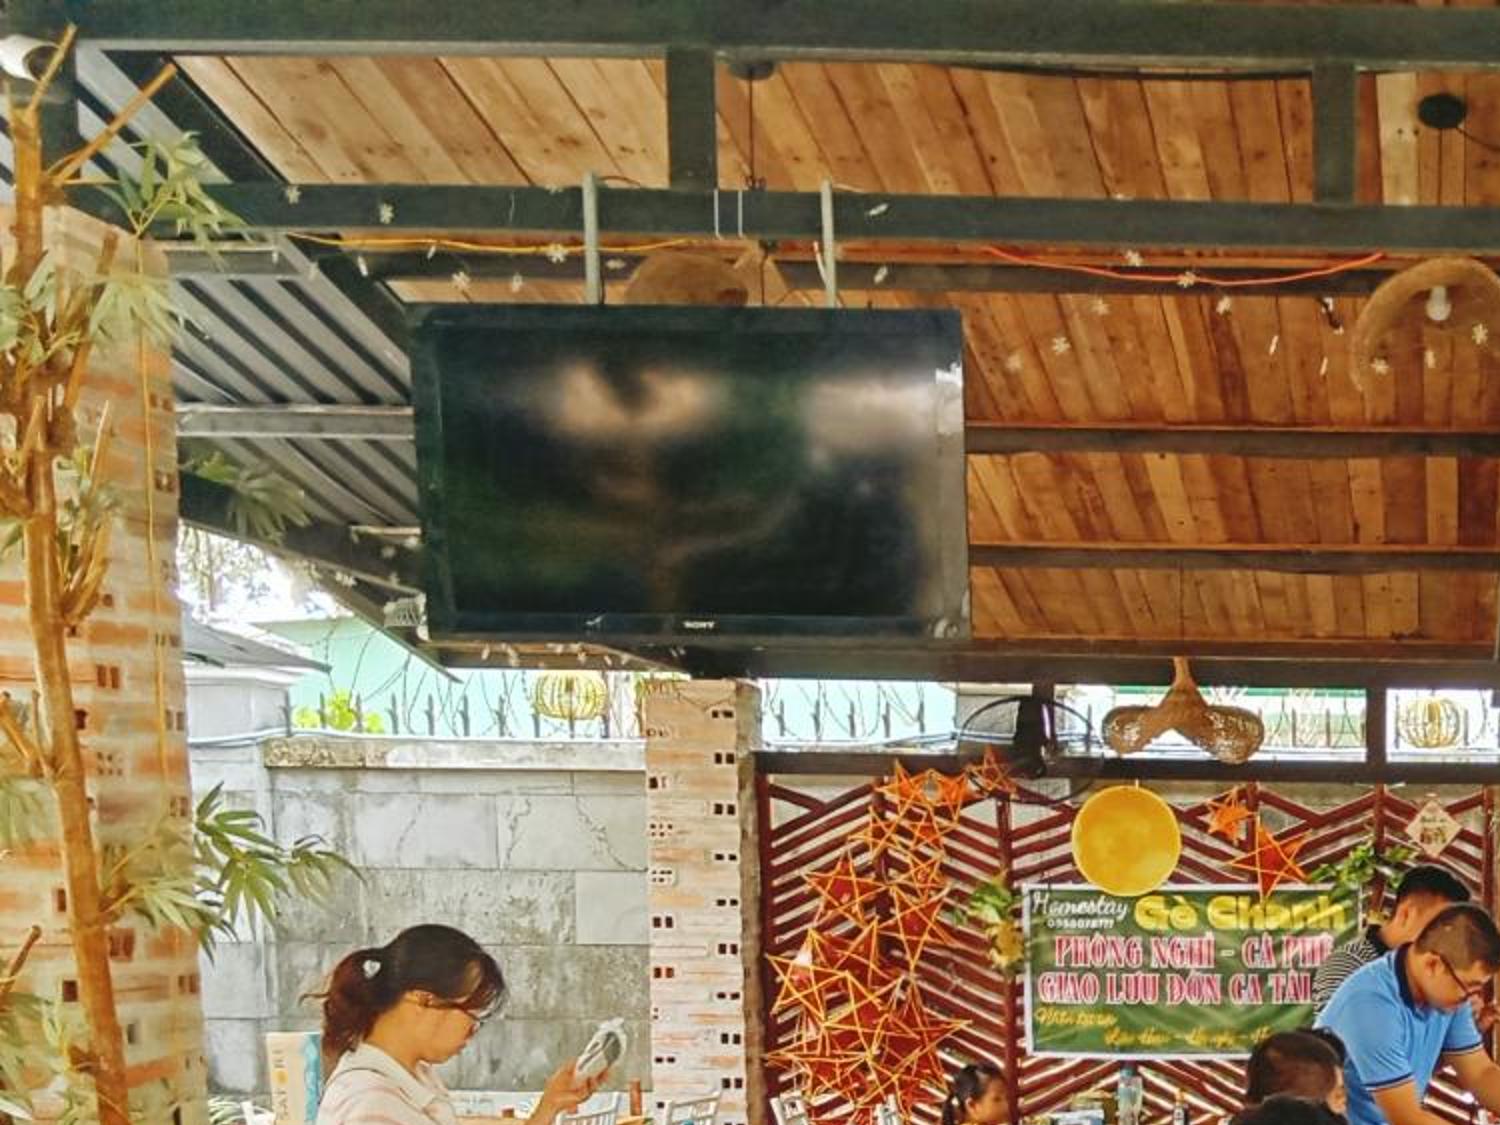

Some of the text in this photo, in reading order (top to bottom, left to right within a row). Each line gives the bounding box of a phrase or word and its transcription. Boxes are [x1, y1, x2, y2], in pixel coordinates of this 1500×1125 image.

[1032, 892, 1128, 920] Homestay
[1134, 895, 1197, 929] Gò
[1038, 972, 1099, 1004] GIAO
[1228, 973, 1263, 1004] CA
